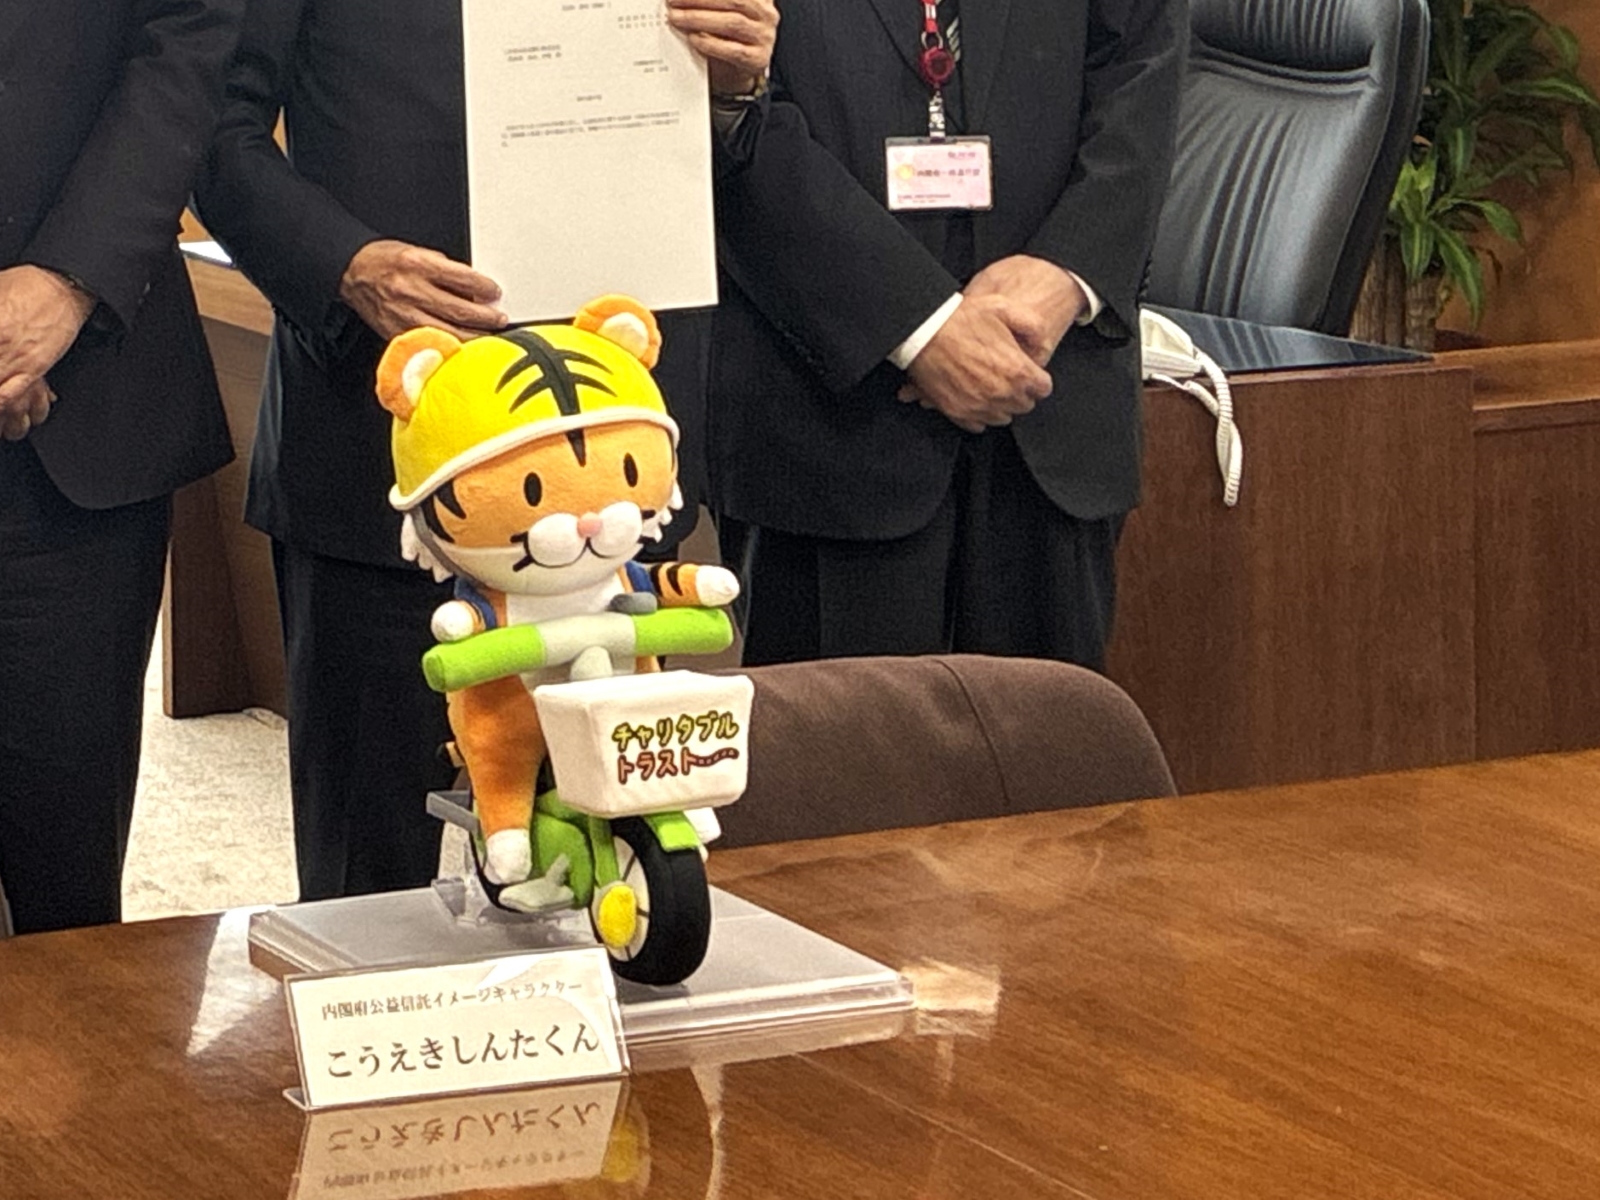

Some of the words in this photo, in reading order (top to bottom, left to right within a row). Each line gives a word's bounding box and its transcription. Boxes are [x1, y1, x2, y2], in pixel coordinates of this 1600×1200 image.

[611, 710, 739, 753] チャリタブル
[327, 1022, 599, 1078] こうえきしんたくん
